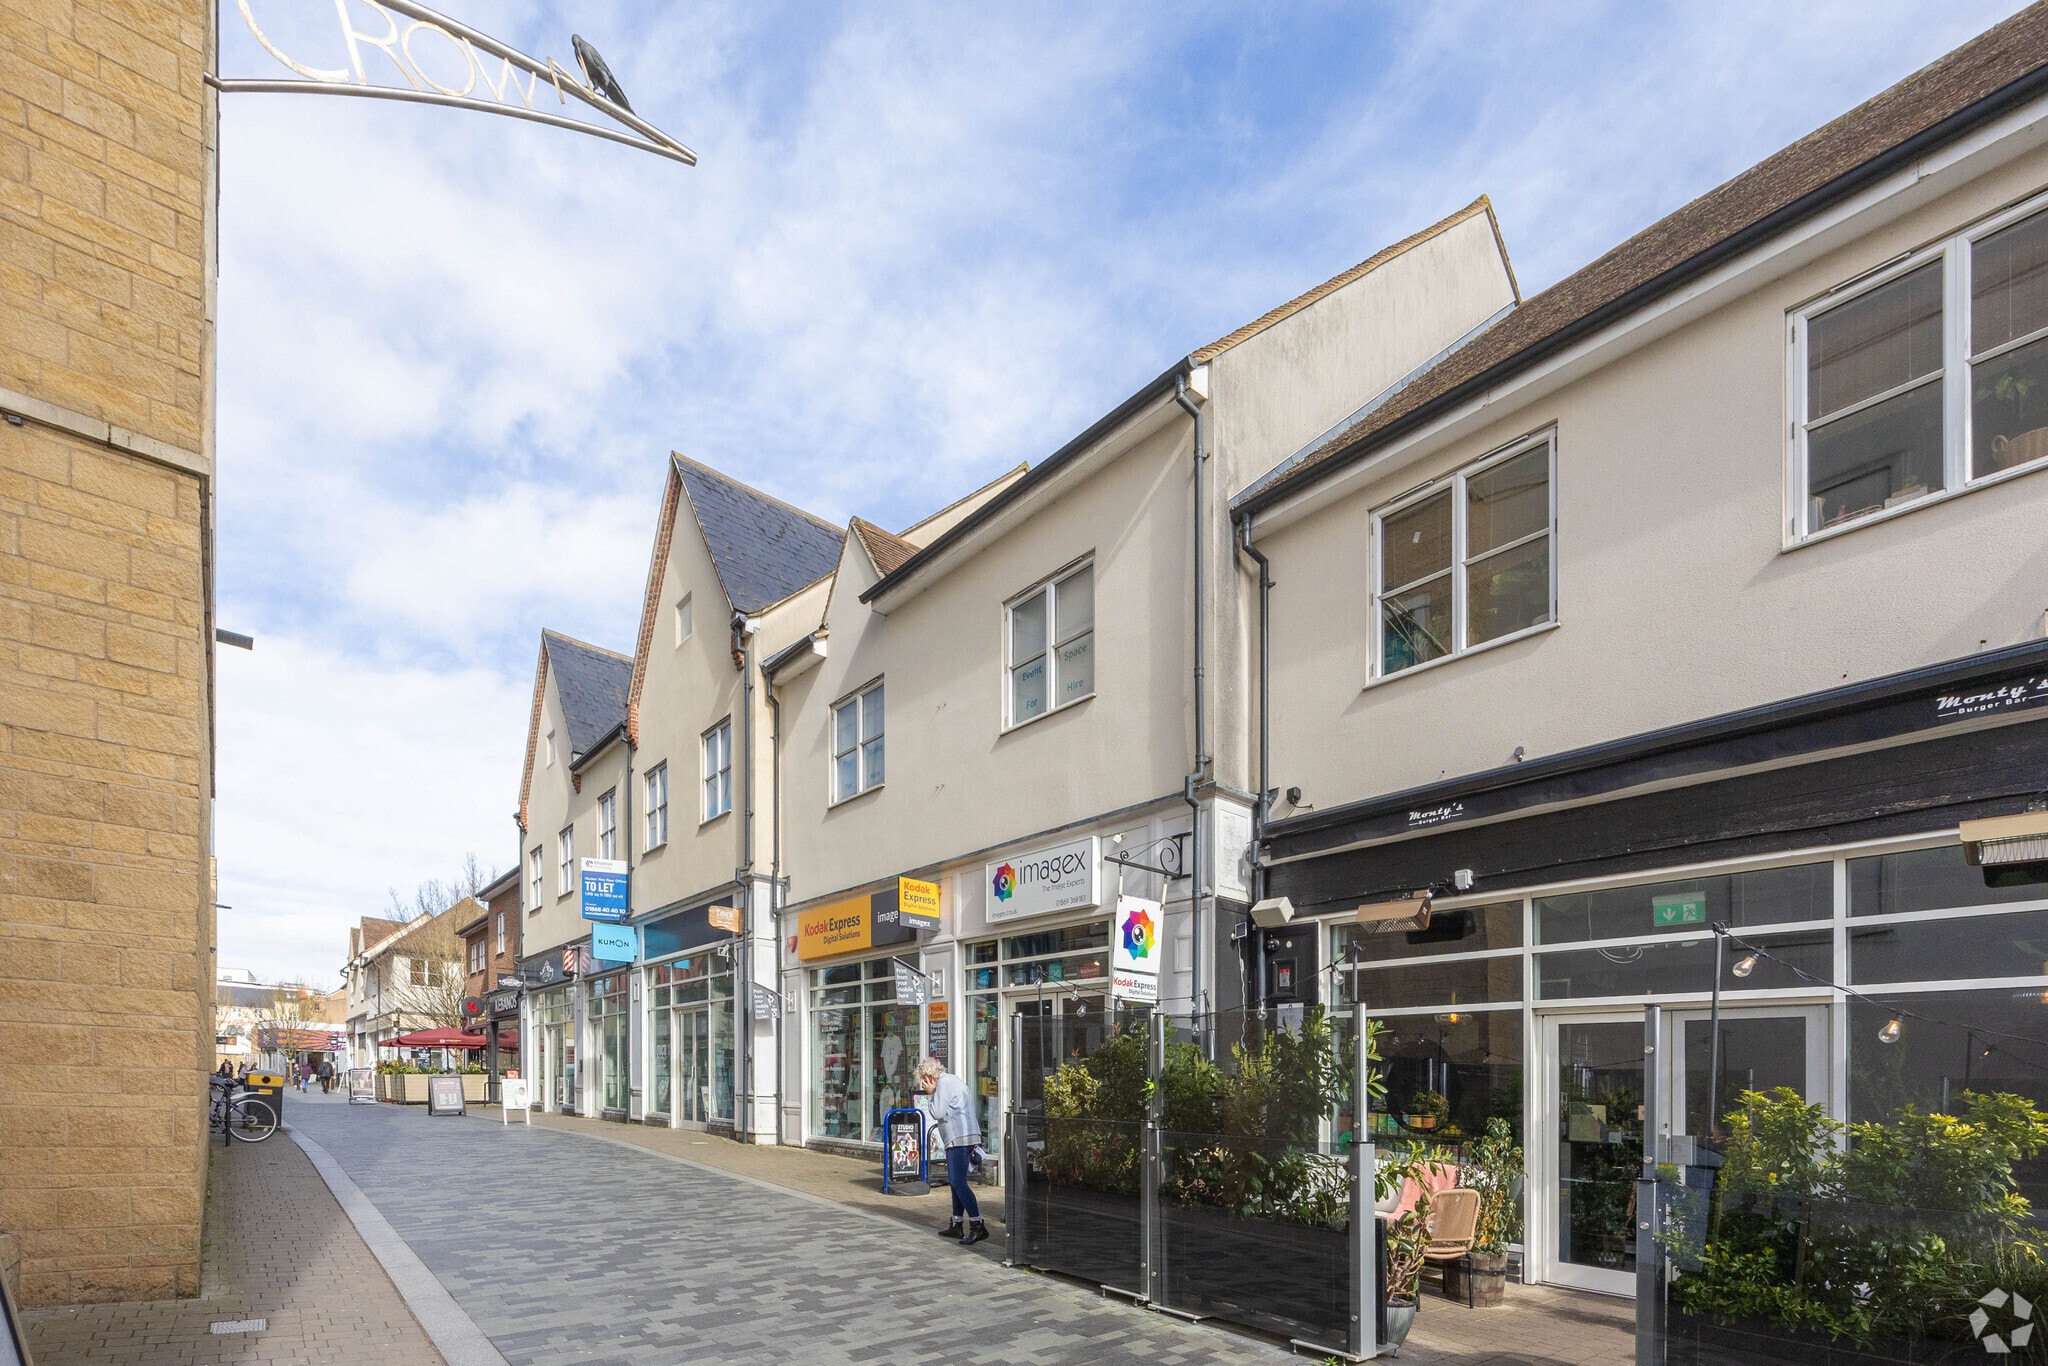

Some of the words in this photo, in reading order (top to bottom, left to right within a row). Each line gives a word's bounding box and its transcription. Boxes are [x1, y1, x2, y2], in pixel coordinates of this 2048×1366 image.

[1022, 665, 1042, 682] Event
[1064, 644, 1087, 662] Space
[1026, 698, 1038, 710] For
[1067, 679, 1084, 693] Hire
[1936, 678, 2048, 710] Monty's
[1958, 701, 2000, 714] Burger
[2005, 697, 2029, 706] Bar
[1409, 802, 1464, 821] Monty's
[1418, 817, 1439, 825] Burger
[1019, 851, 1086, 884] imagex
[584, 881, 597, 892] TO
[598, 882, 615, 893] LET
[904, 881, 930, 894] Kodak
[1042, 885, 1051, 893] The
[1052, 882, 1066, 891] Image
[1066, 878, 1085, 888] Experts
[904, 891, 936, 905] Express
[877, 910, 899, 923] image
[908, 916, 931, 928] imagex
[804, 920, 829, 937] Kodak
[829, 915, 861, 934] Express
[598, 938, 630, 948] KUMON
[823, 934, 838, 945] Digital
[838, 930, 861, 941] Solutions
[1113, 976, 1134, 988] Kodak
[1133, 980, 1157, 991] Express
